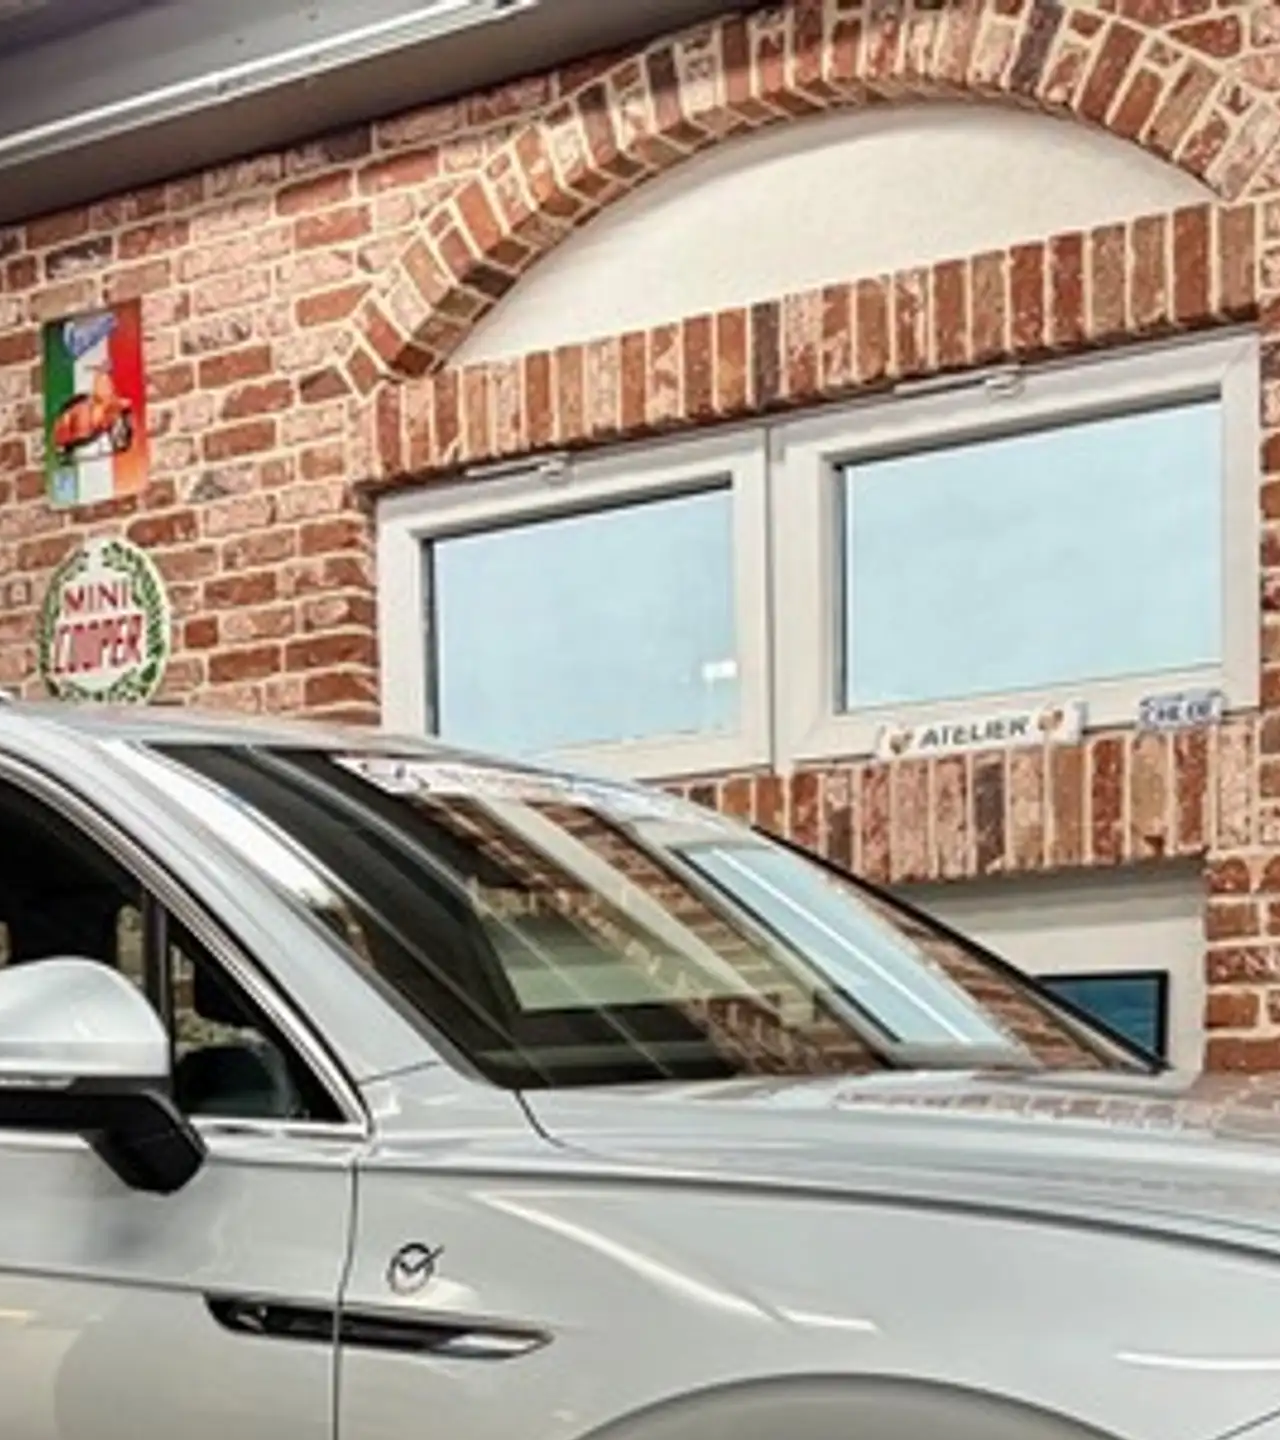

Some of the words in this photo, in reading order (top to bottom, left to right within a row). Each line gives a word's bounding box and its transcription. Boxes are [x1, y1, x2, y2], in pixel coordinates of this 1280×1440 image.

[64, 578, 129, 615] MINI
[53, 614, 143, 675] COOPER
[921, 714, 1032, 747] ATELIER
